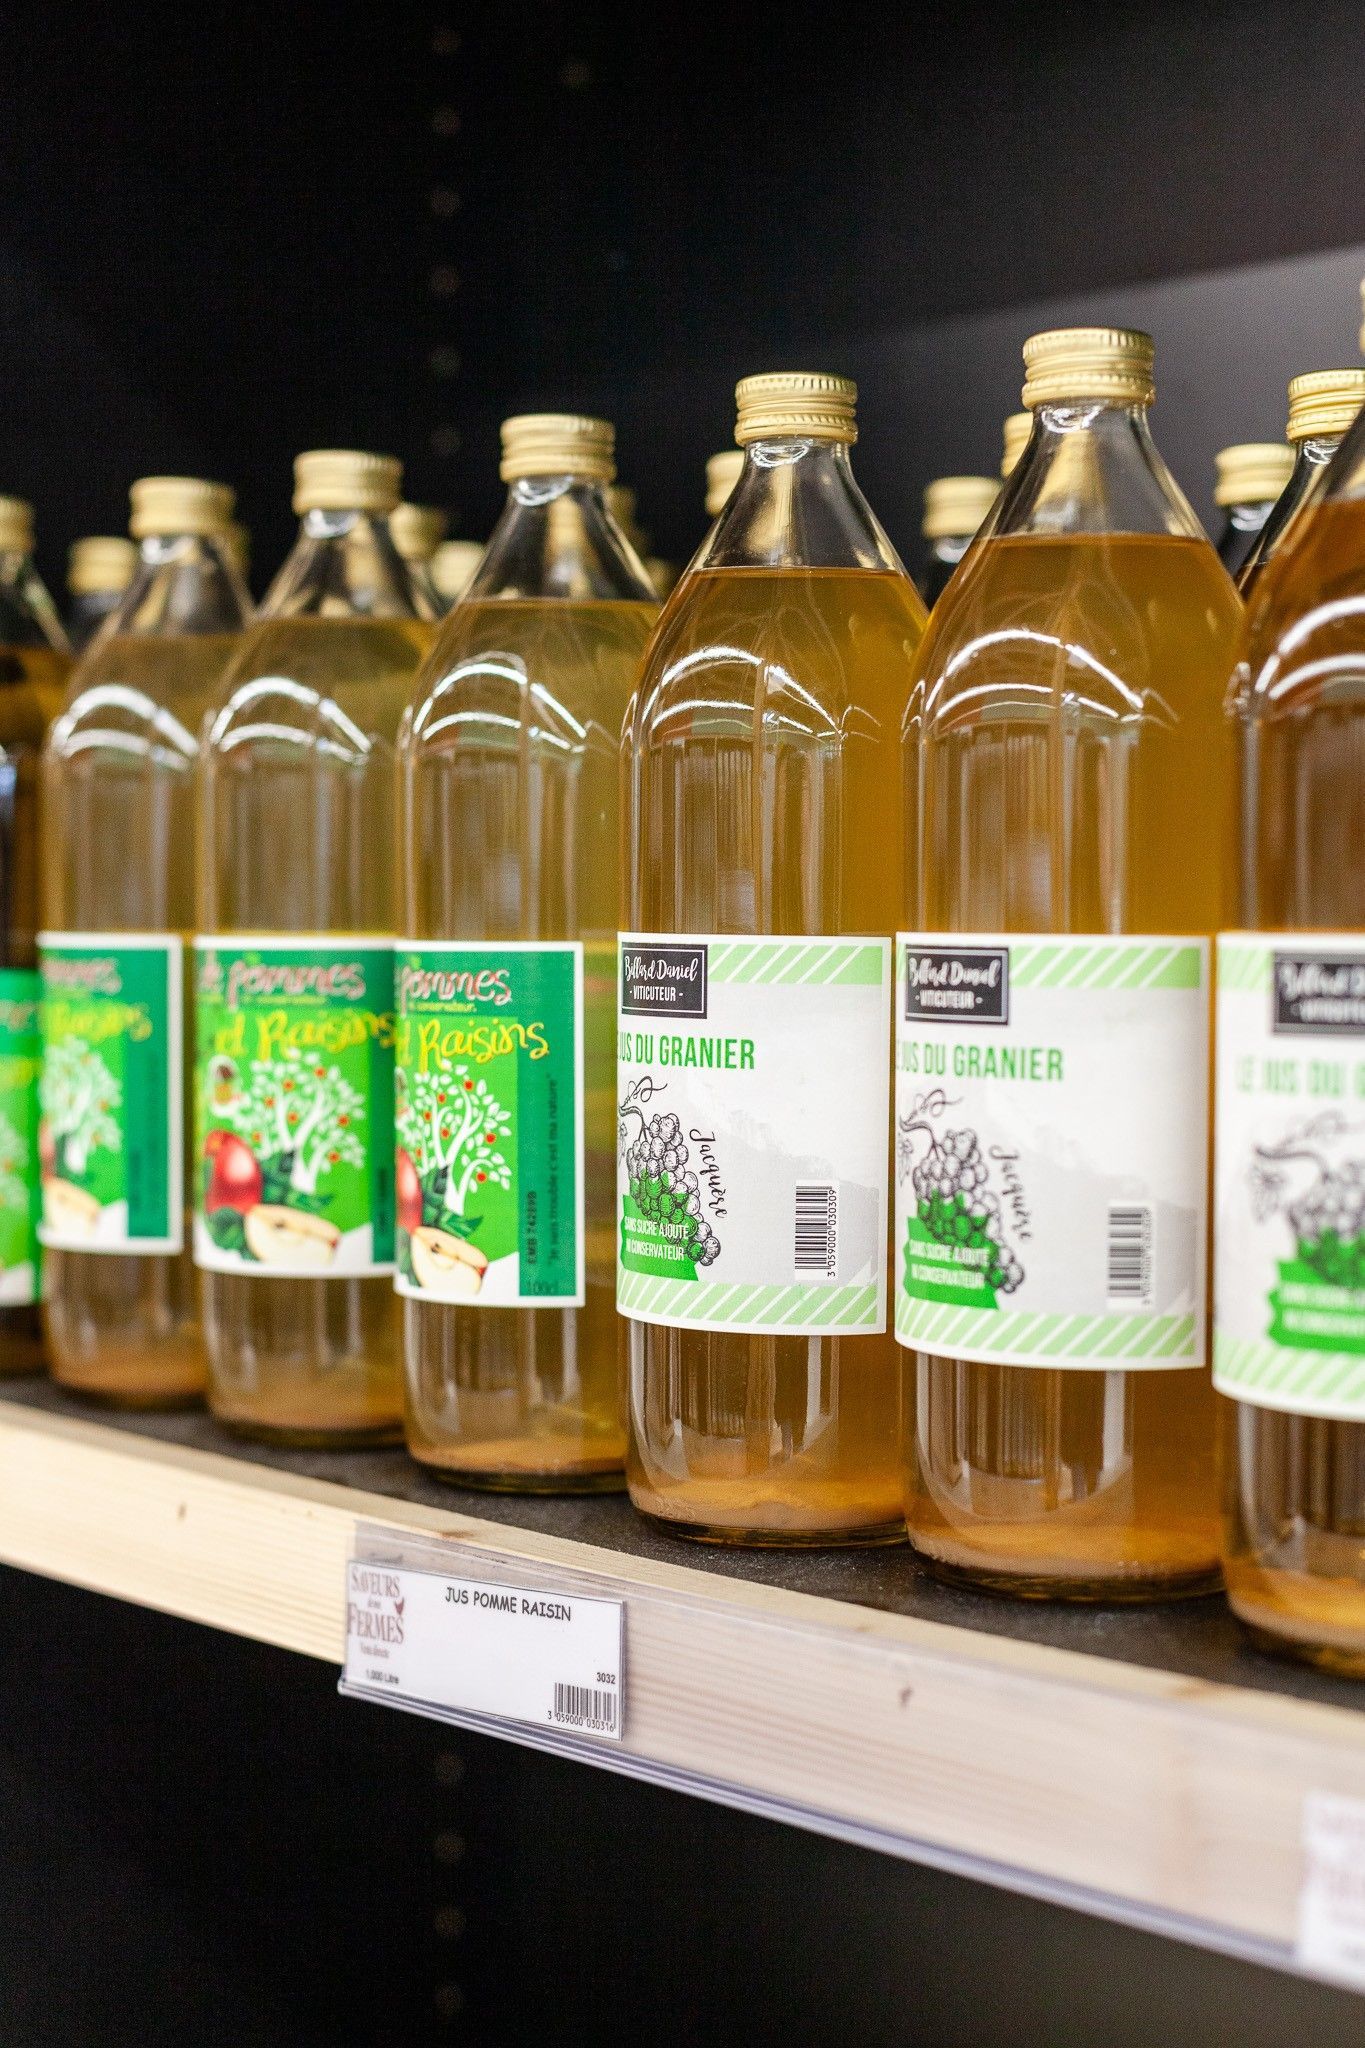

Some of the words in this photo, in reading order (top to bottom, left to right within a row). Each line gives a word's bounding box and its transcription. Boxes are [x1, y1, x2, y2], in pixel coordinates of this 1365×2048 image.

[624, 955, 656, 982] Billard
[656, 957, 699, 982] Daniel
[418, 1018, 549, 1073] Raisins
[636, 1033, 654, 1065] DU
[659, 1035, 755, 1070] GRANIER
[924, 1043, 946, 1075] DU
[953, 1044, 1064, 1081] GRANIER
[689, 1128, 728, 1219] Jacquère
[658, 1221, 689, 1240] AJOUTÉ
[445, 1587, 469, 1605] JUS
[473, 1591, 517, 1614] POMME
[521, 1599, 571, 1621] RAISIN
[596, 1672, 616, 1685] 3032
